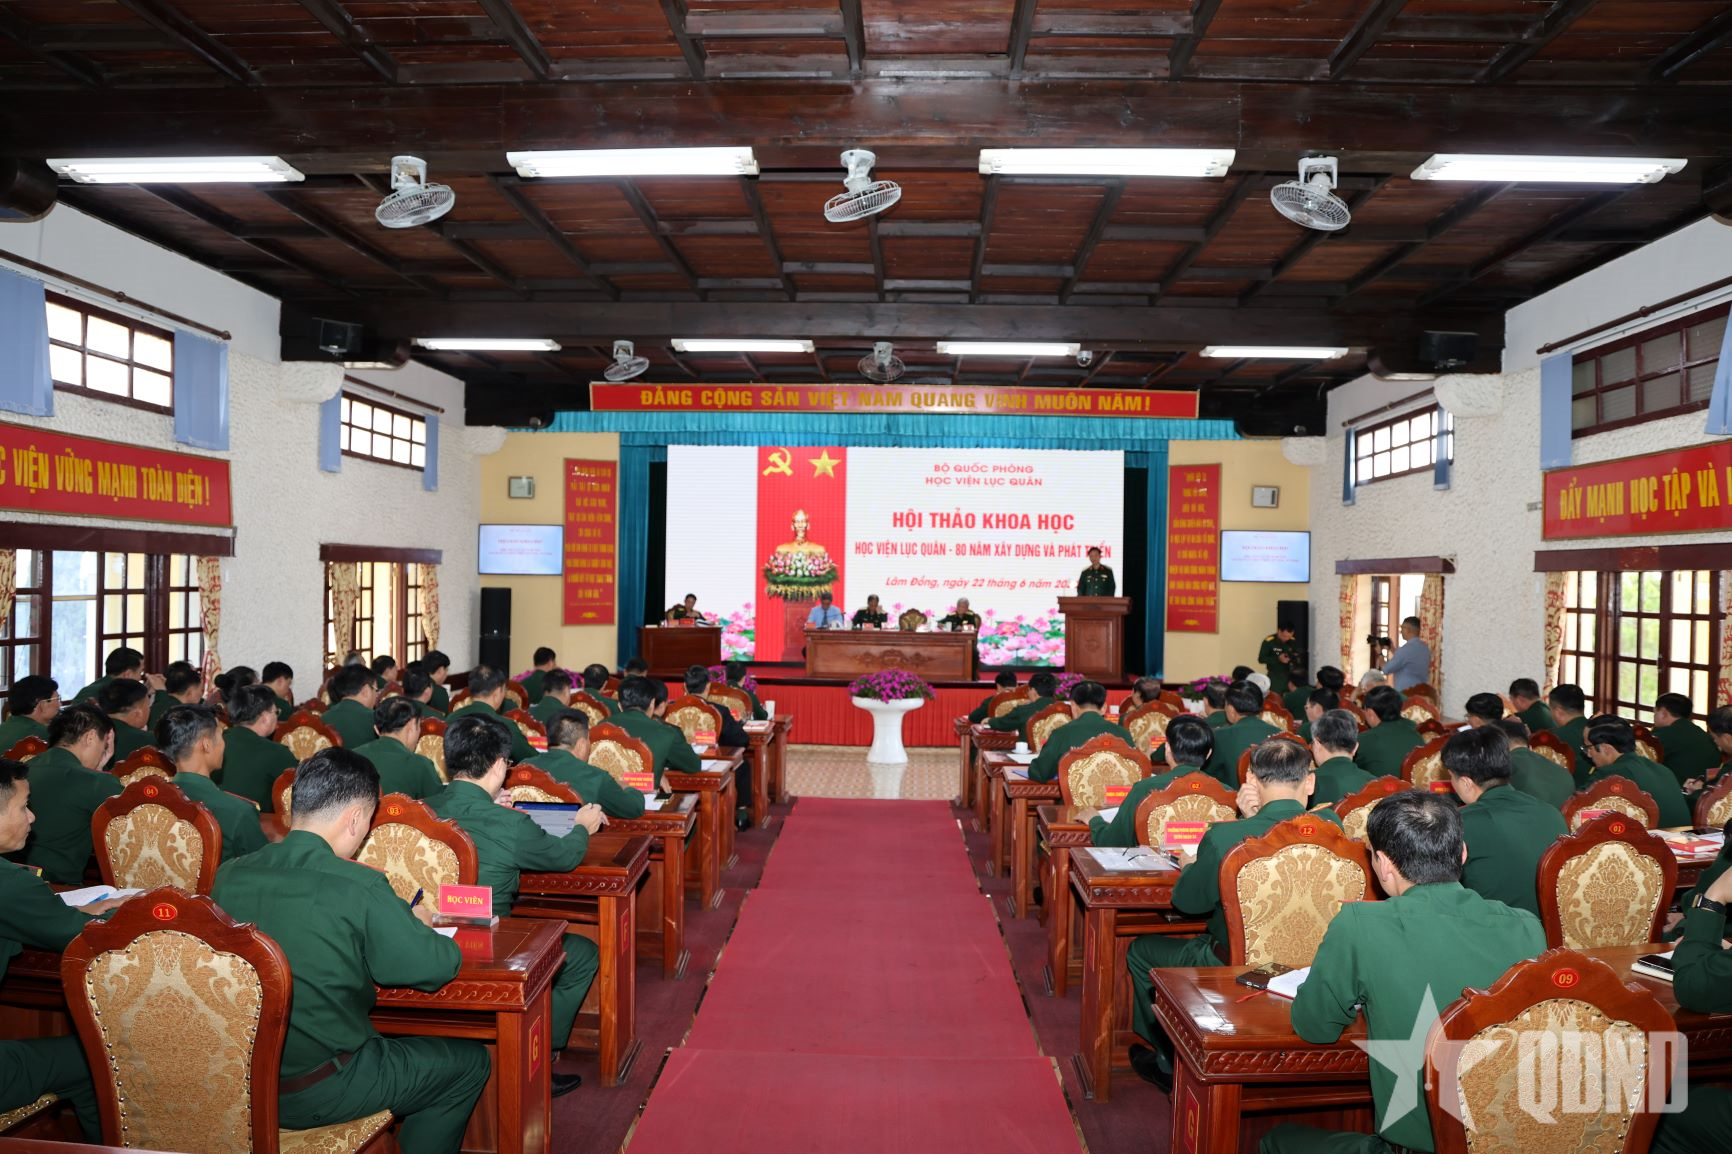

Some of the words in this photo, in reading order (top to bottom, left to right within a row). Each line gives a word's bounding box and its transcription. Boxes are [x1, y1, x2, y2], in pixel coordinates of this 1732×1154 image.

[640, 385, 692, 406] ĐẢNG
[701, 387, 752, 408] CỘNG
[760, 386, 799, 406] SẢN
[807, 387, 849, 408] VIỆT
[859, 391, 903, 407] NAM
[910, 391, 976, 409] QUANG
[1034, 391, 1092, 410] MUÔN
[12, 445, 49, 494] VIỆN
[55, 448, 93, 494] VỮNG
[97, 461, 137, 502] MẠNH
[141, 463, 173, 502] TOÀN
[933, 463, 950, 475] BỘ
[953, 462, 989, 474] QUỐC
[992, 464, 1034, 474] PHÒNG
[925, 476, 952, 488] HỌC
[955, 475, 981, 488] VIỆN
[1008, 475, 1042, 486] QUÂN
[1586, 481, 1624, 523] MẠNH
[1629, 475, 1658, 520] HỌC
[1662, 467, 1691, 517] TẬP
[1697, 461, 1720, 507] VÀ
[893, 507, 923, 532] HỘI
[929, 506, 976, 529] THẢO
[982, 513, 1031, 530] KHOA
[1037, 513, 1075, 535] HỌC
[855, 541, 874, 559] HỌC
[876, 539, 898, 559] VIỆN
[920, 540, 947, 558] QUÂN
[955, 543, 967, 557] 80
[969, 541, 992, 557] NĂM
[994, 541, 1012, 557] XÂY
[1015, 543, 1041, 560] DỰNG
[1043, 542, 1055, 557] VÀ
[1058, 542, 1081, 558] PHÁT
[886, 576, 907, 586] Lâm
[943, 578, 970, 590] ngày
[971, 578, 985, 588] 22
[987, 578, 1017, 591] tháng
[1019, 579, 1026, 588] 6
[1029, 579, 1052, 588] năm
[1302, 827, 1314, 835] 12
[465, 896, 484, 905] VIÊN
[158, 908, 170, 917] 11
[1558, 974, 1574, 985] 09
